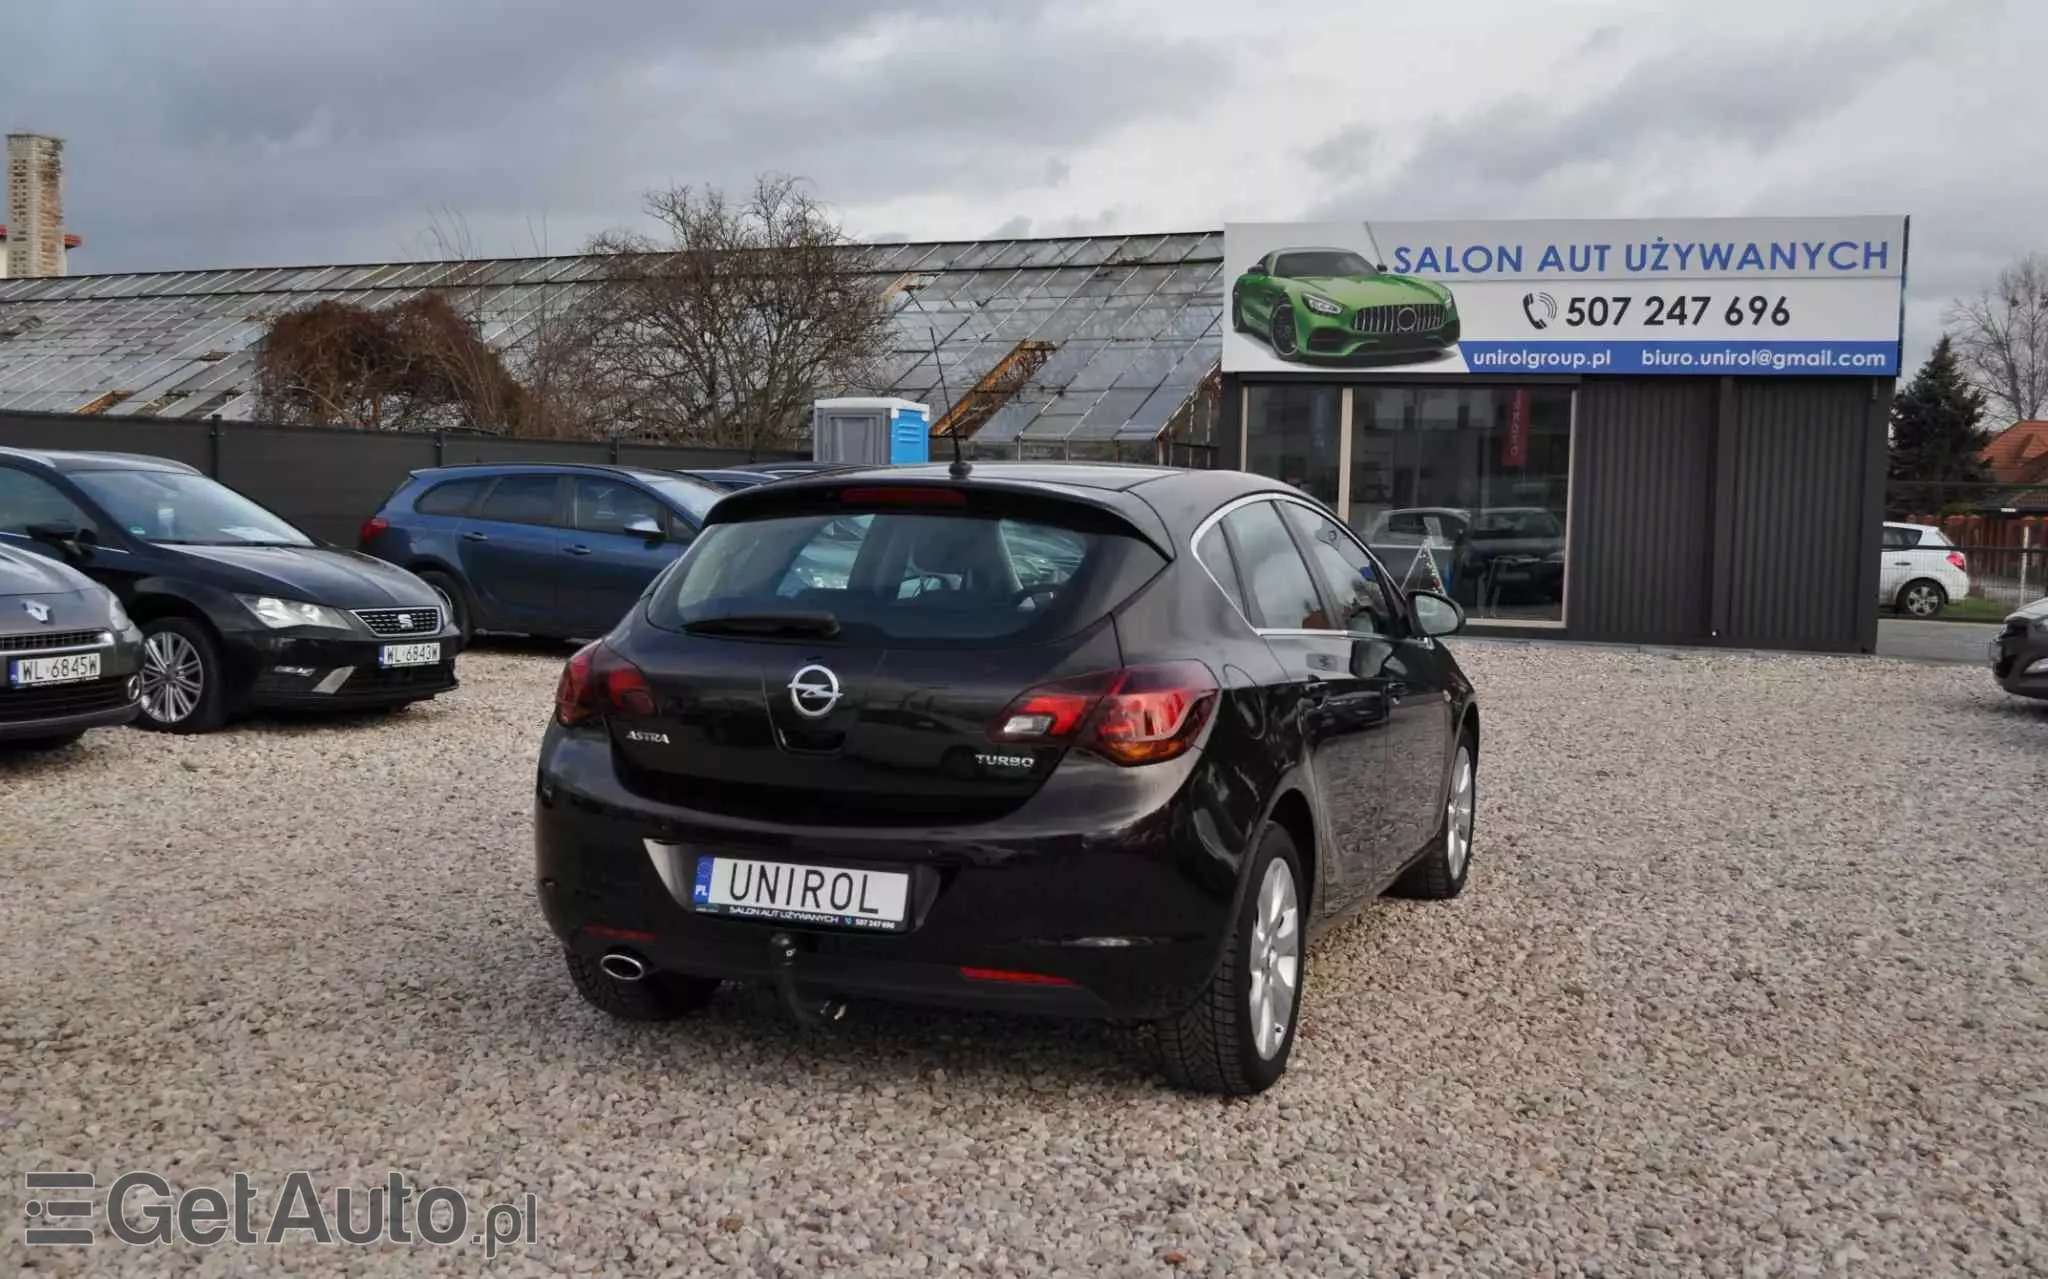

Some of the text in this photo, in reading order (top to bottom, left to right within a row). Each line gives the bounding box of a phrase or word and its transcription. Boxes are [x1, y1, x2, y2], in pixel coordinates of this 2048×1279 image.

[1394, 236, 1889, 274] SALON AUT UŻYWANYCH
[1566, 296, 1791, 327] 507 247 696
[1473, 348, 1886, 370] unirolgroup.pl biuro.unirol@gmail.com
[387, 647, 401, 663] WL
[23, 655, 98, 681] WL 6845W
[626, 730, 670, 745] ASTRA
[975, 754, 1035, 768] TURBO
[729, 862, 879, 915] UNIROL
